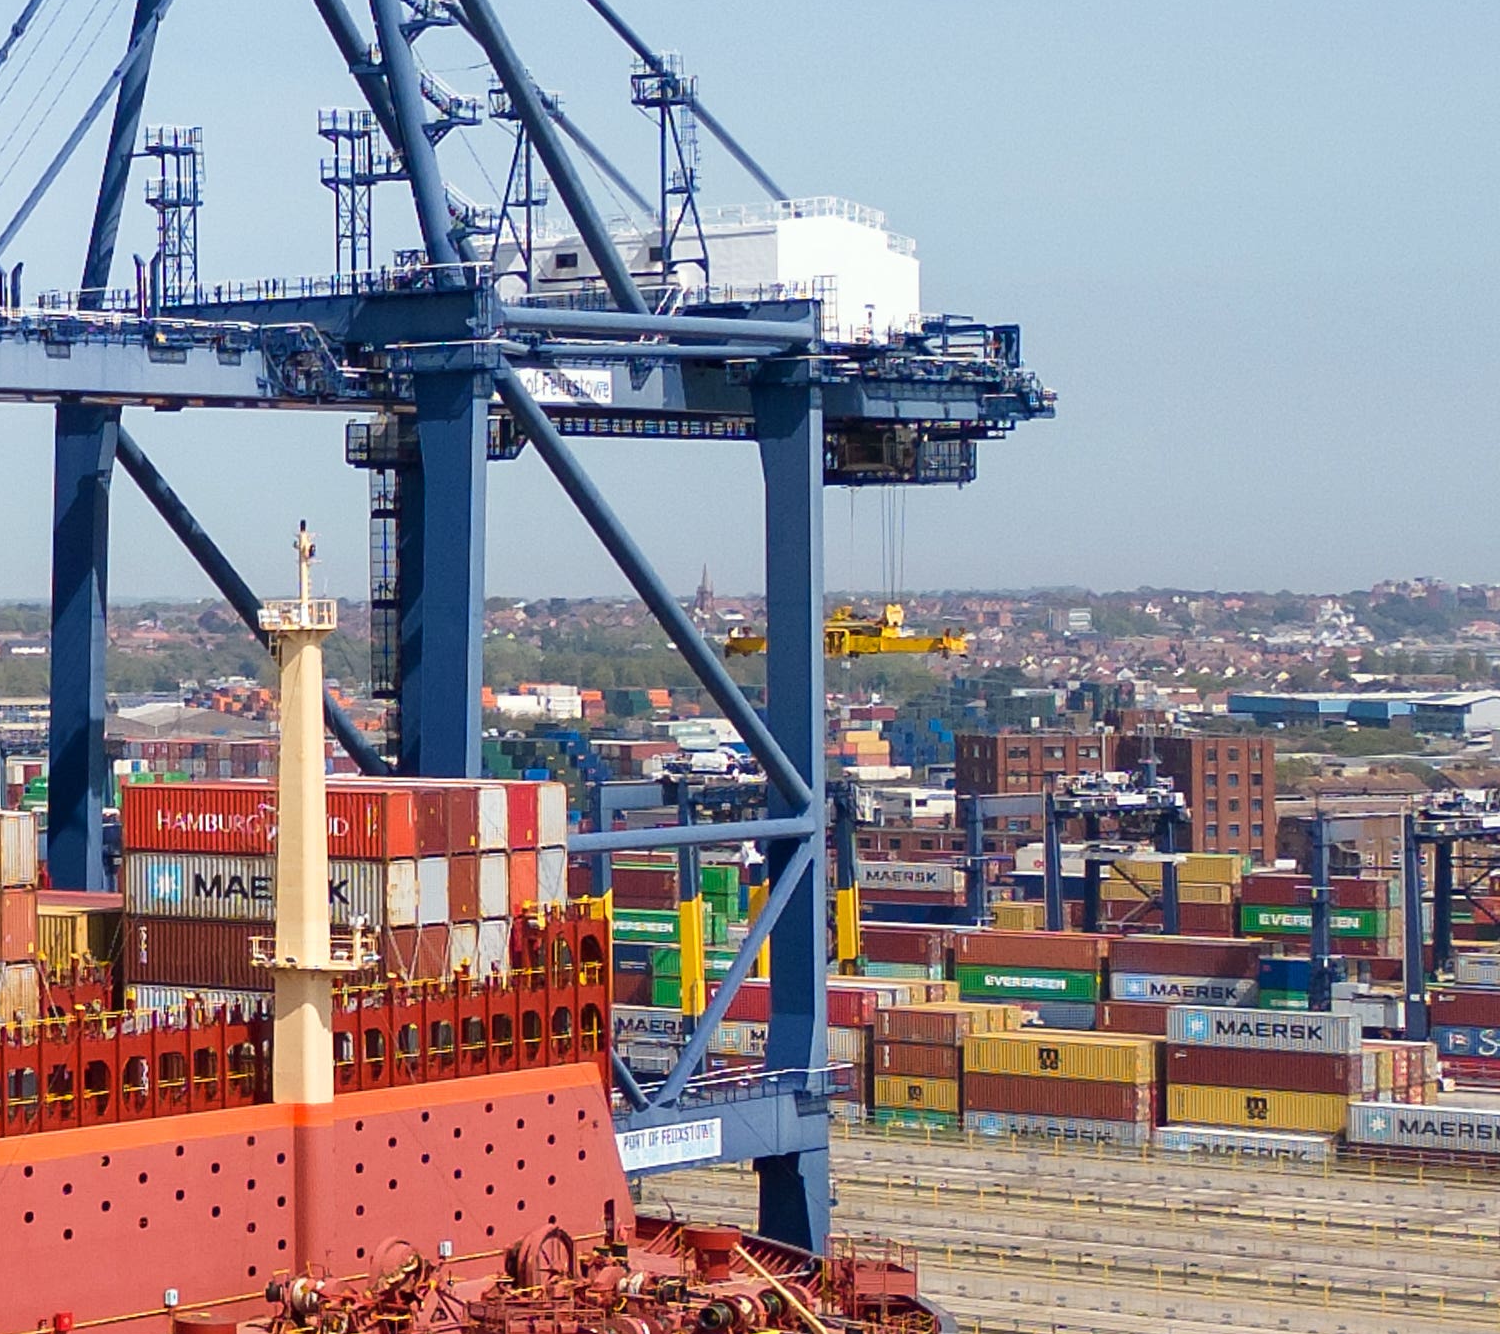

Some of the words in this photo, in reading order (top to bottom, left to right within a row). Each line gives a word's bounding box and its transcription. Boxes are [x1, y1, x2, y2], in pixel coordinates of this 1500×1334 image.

[156, 808, 261, 835] HAMBURG
[865, 870, 937, 884] MAERSK
[194, 874, 349, 904] MAEK
[984, 974, 1067, 990] EVERGREEN
[1150, 983, 1238, 1000] MAERSK
[1216, 1020, 1323, 1041] MAERSK
